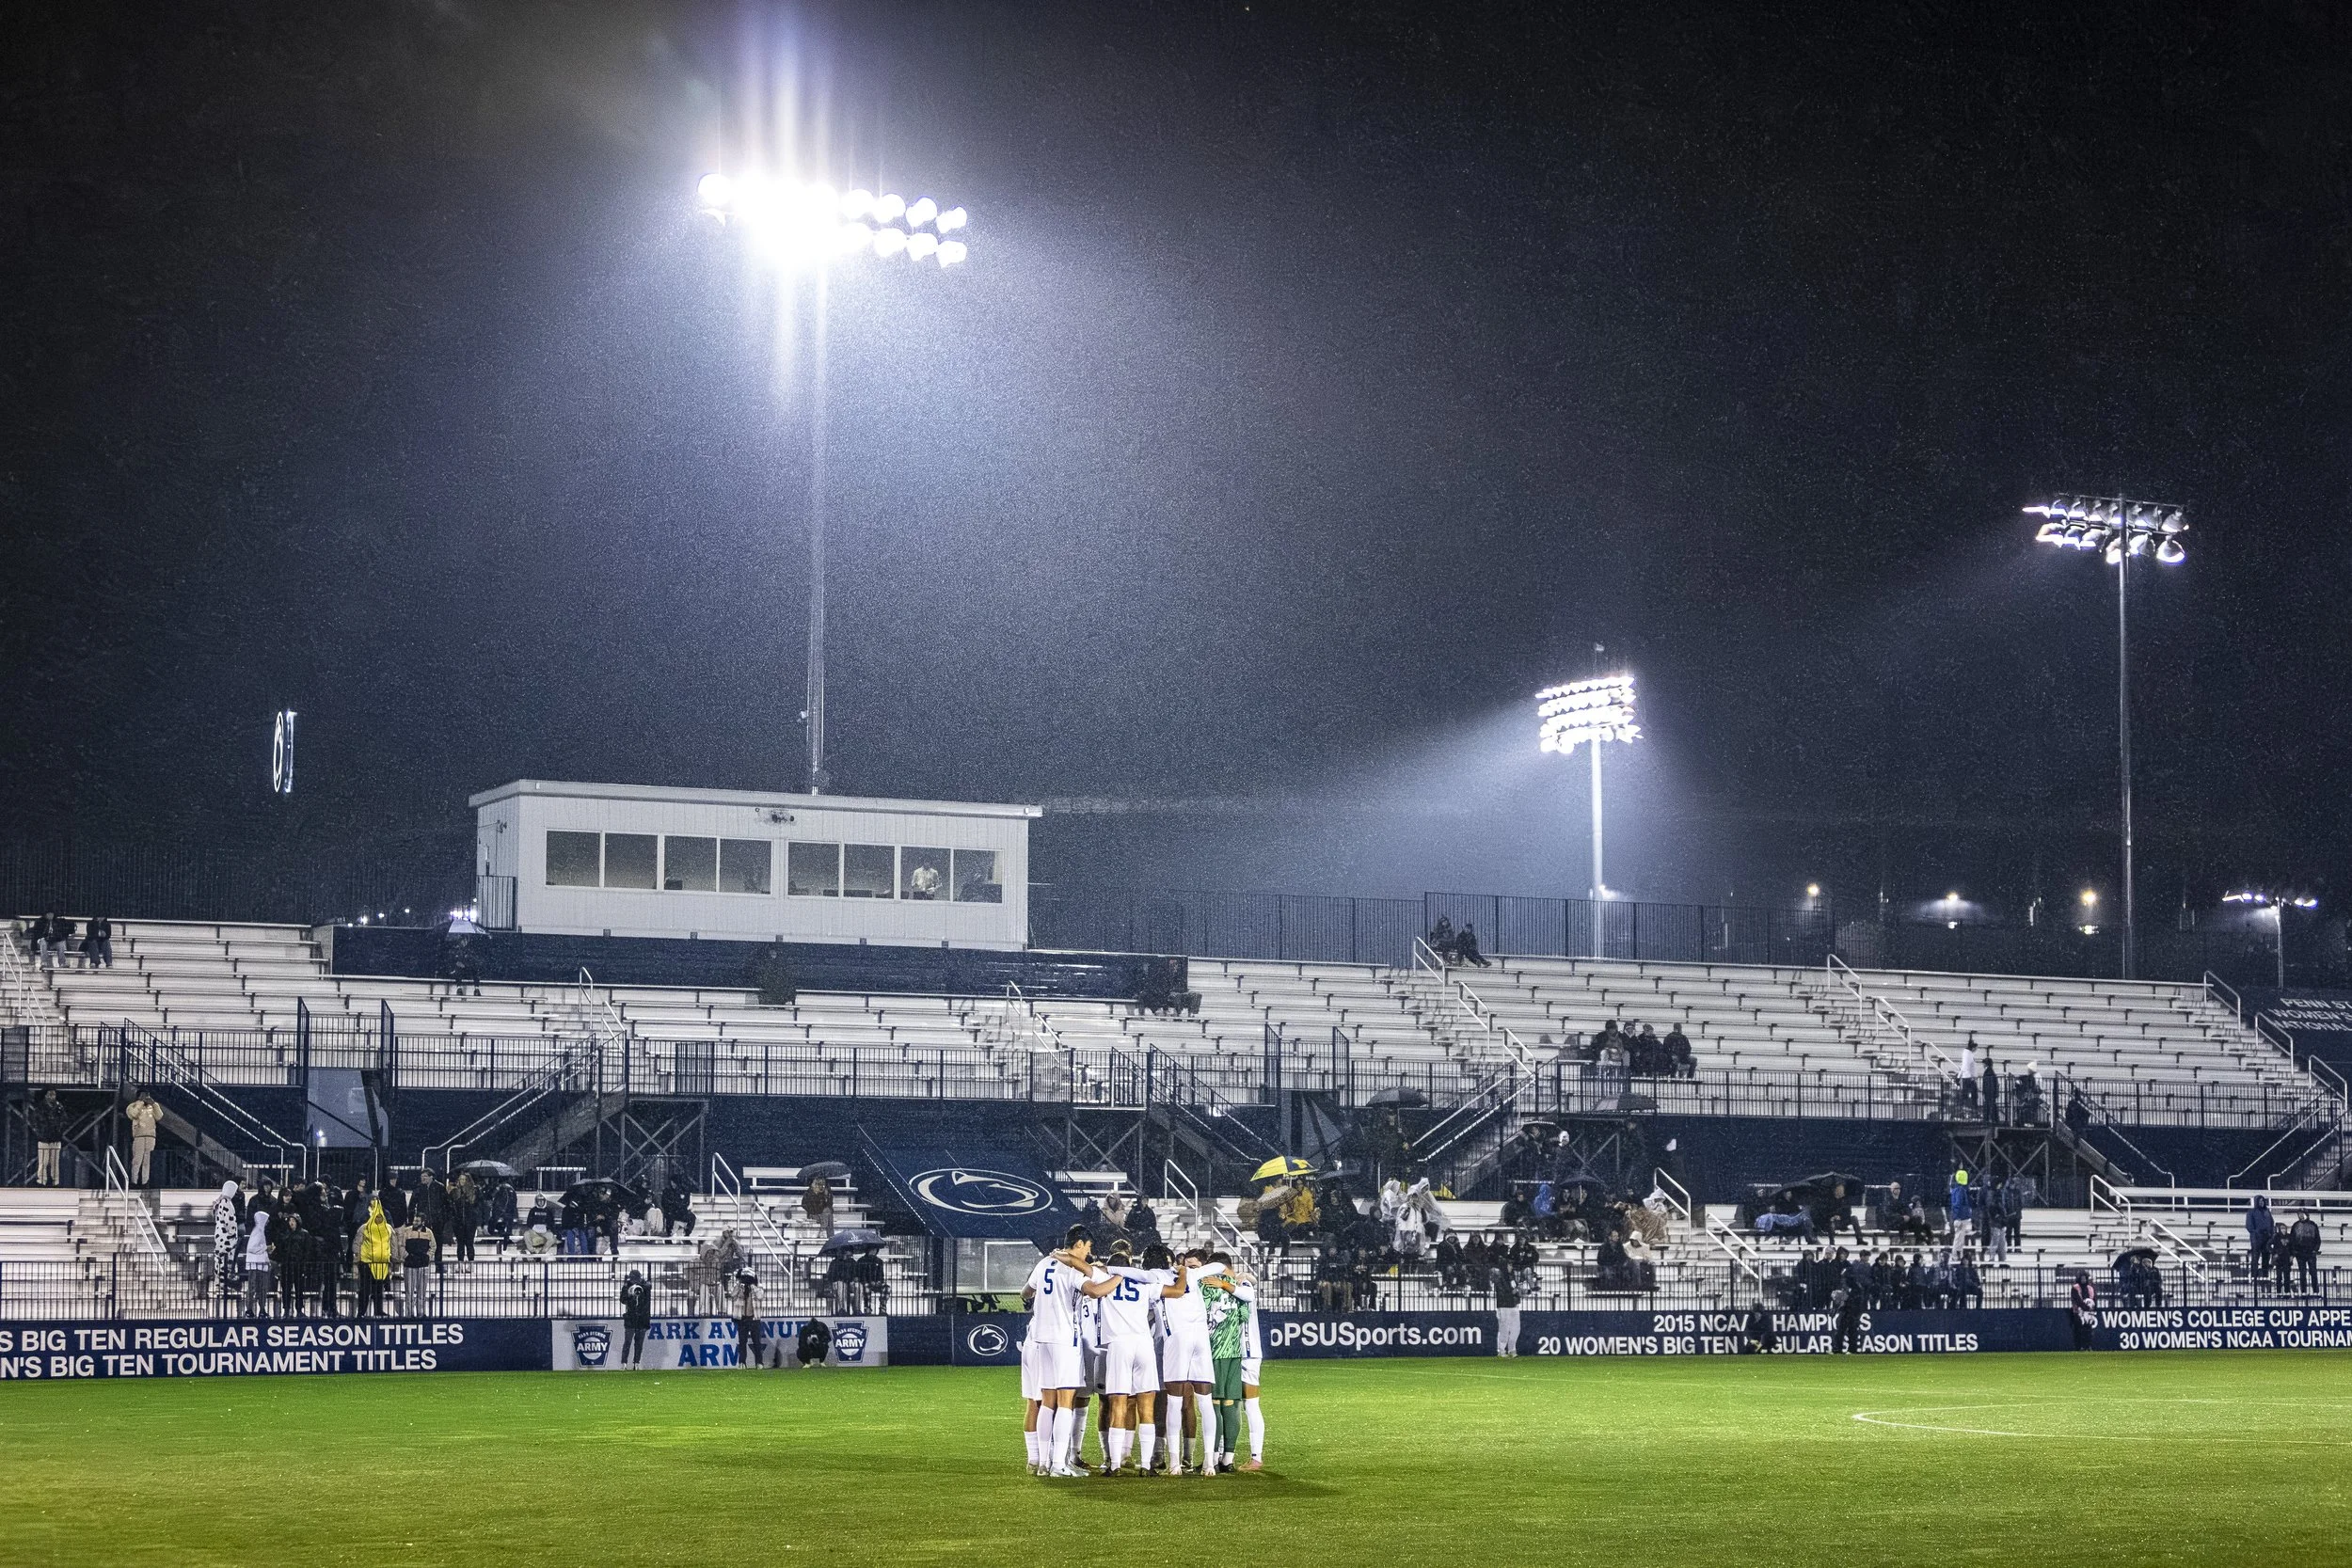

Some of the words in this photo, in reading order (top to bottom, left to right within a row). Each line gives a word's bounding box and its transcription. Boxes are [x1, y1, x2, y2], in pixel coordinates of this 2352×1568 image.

[2280, 998, 2331, 1008] PENN
[1043, 1268, 1055, 1294] 5
[1113, 1276, 1139, 1302] 15
[1653, 1315, 1694, 1332] 2015
[1772, 1313, 1871, 1332] HAMPIS
[2102, 1310, 2183, 1328] WOMEN'S
[2187, 1310, 2265, 1327] COLLEGE
[2269, 1309, 2304, 1327] CUP
[2308, 1309, 2352, 1327] APPE
[0, 1331, 13, 1352] S
[22, 1330, 66, 1351] BIG
[73, 1329, 125, 1350] TEN
[135, 1325, 259, 1349] REGULAR
[266, 1324, 371, 1347] SEASON
[378, 1323, 464, 1345] TITLES
[647, 1322, 700, 1340] ARK
[708, 1321, 810, 1339] AVNU
[2120, 1332, 2139, 1350] 30
[2142, 1331, 2222, 1349] WOMEN'S
[2227, 1330, 2274, 1348] NCAA
[576, 1342, 608, 1352] ARMY
[835, 1338, 865, 1348] ARMY
[1538, 1337, 1561, 1354] 20
[1565, 1336, 1657, 1354] WOMEN'S
[1663, 1336, 1695, 1354] BIG
[1701, 1336, 1738, 1354] TEN
[1744, 1335, 1833, 1354] GULAR
[1917, 1334, 1979, 1352] TITLES
[50, 1354, 94, 1377] BIG
[103, 1354, 153, 1376] TEN
[162, 1352, 345, 1375] TOURNAMENT
[352, 1349, 437, 1371] TITLES
